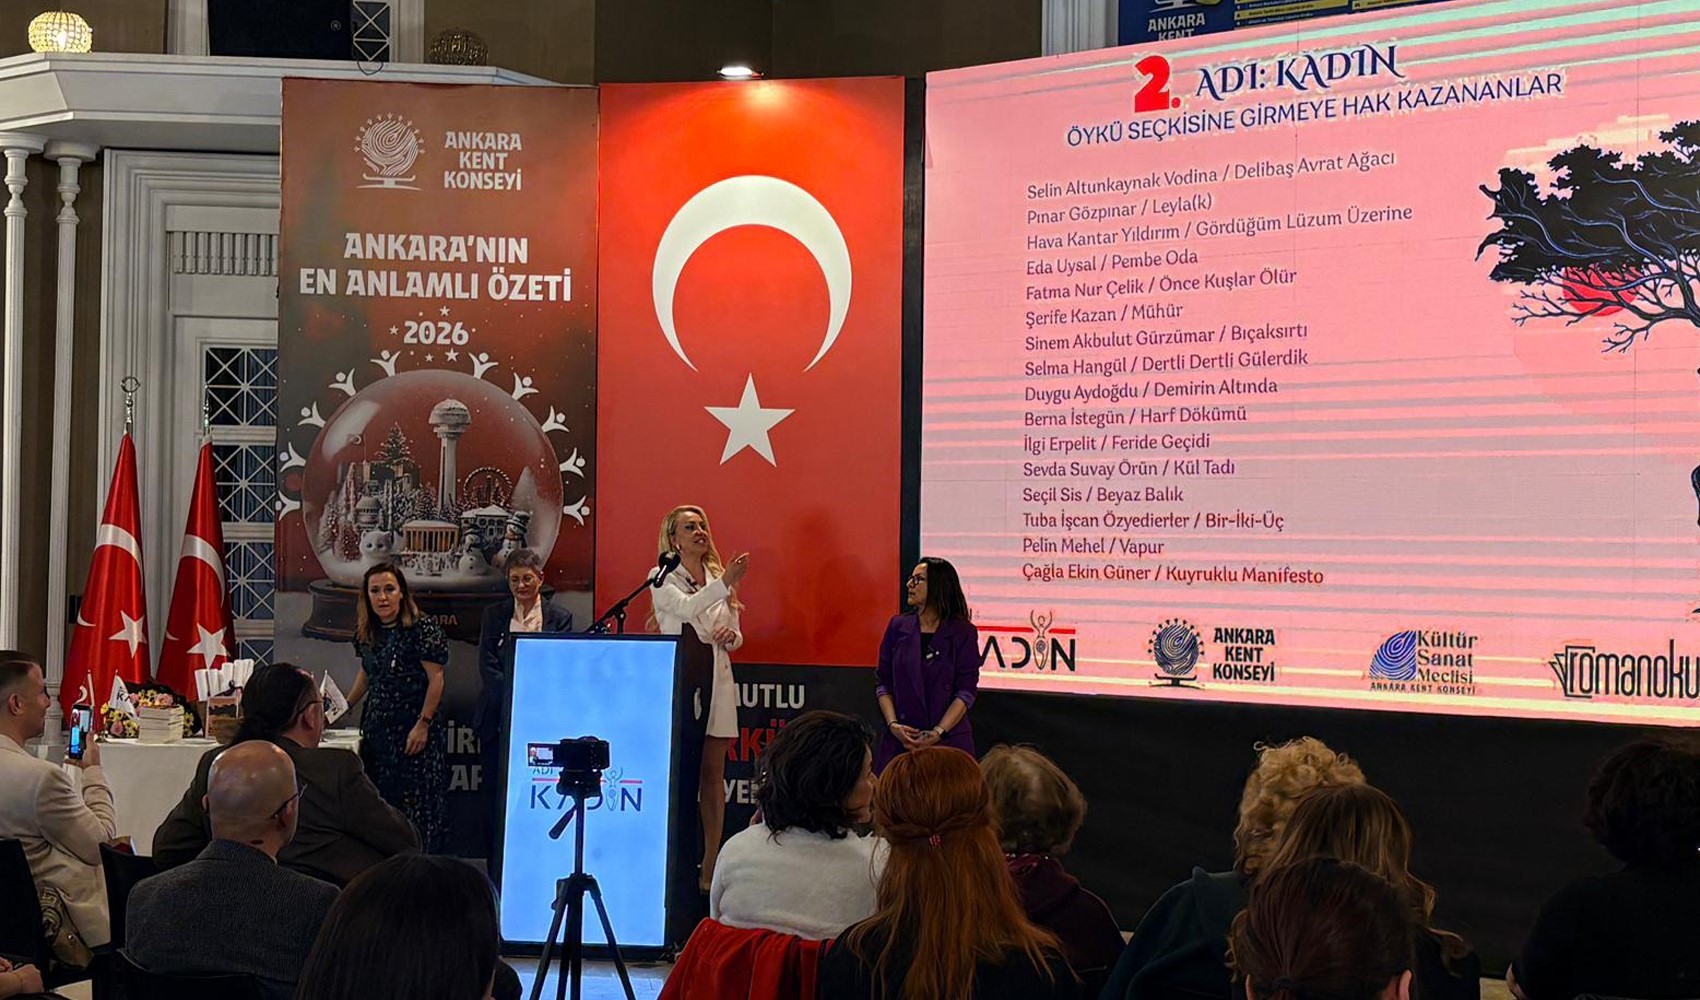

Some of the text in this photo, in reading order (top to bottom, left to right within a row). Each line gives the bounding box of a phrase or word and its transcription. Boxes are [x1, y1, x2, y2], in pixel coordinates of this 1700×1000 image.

[1147, 12, 1206, 32] ANKARA
[1134, 43, 1406, 113] 2. ADI: KADIN
[1067, 73, 1562, 147] ÖYKÜ SEÇKİSİNE GİRMEYE HAK KAZANANLAR
[444, 131, 522, 151] ANKARA
[459, 152, 508, 170] KENT
[444, 168, 522, 191] KONSEYİ
[1027, 151, 1395, 199] Selin Altunkaynak Vodina / Delibaş Avrat Ağacı
[1027, 193, 1212, 224] Pınar Gözpınar / Leyla(k)
[1027, 205, 1412, 250] Hava Kantar Yıldırım / Gördüğüm Lüzum Üzerine
[344, 232, 528, 264] ANKARA'NIN
[1026, 248, 1198, 277] Eda Uysal / Pembe Oda
[300, 266, 571, 302] EN ANLAMLI ÖZETİ
[1026, 268, 1297, 300] Fatma Nur Çelik / Önce Kuşlar Ölür
[1025, 303, 1184, 329] Şerife Kazan / Mühür
[403, 320, 469, 345] 2026
[1025, 323, 1308, 351] Sinem Akbulut Gürzümar / Bıçaksırtı
[1025, 348, 1308, 377] Selma Hangül / Dertli Dertli Gülerdik
[1025, 377, 1278, 405] Duygu Aydoğdu / Demirin Altında
[1025, 405, 1247, 429] Berna İstegün / Harf Dökümü
[1024, 432, 1210, 455] İlgi Erpelit / Feride Geçidi
[1023, 458, 1235, 480] Sevda Suvay Örün / Kül Tadı
[1023, 486, 1184, 506] Seçil Sis / Beyaz Balık
[1023, 509, 1284, 532] Tuba İşcan Özyedierler / Bir-İki-Üç
[1023, 537, 1164, 557] Pelin Mehel / Vapur
[1023, 563, 1324, 585] Çağla Ekin Güner / Kuyruklu Manifesto
[1213, 627, 1275, 645] ANKARA
[1417, 630, 1478, 649] Kültür
[979, 635, 1076, 672] ADIN
[1224, 646, 1264, 663] KENT
[1417, 648, 1473, 668] Sanat
[1213, 661, 1275, 682] KONSEYİ
[1417, 668, 1473, 685] Meclisi
[1370, 682, 1406, 692] ANKARA
